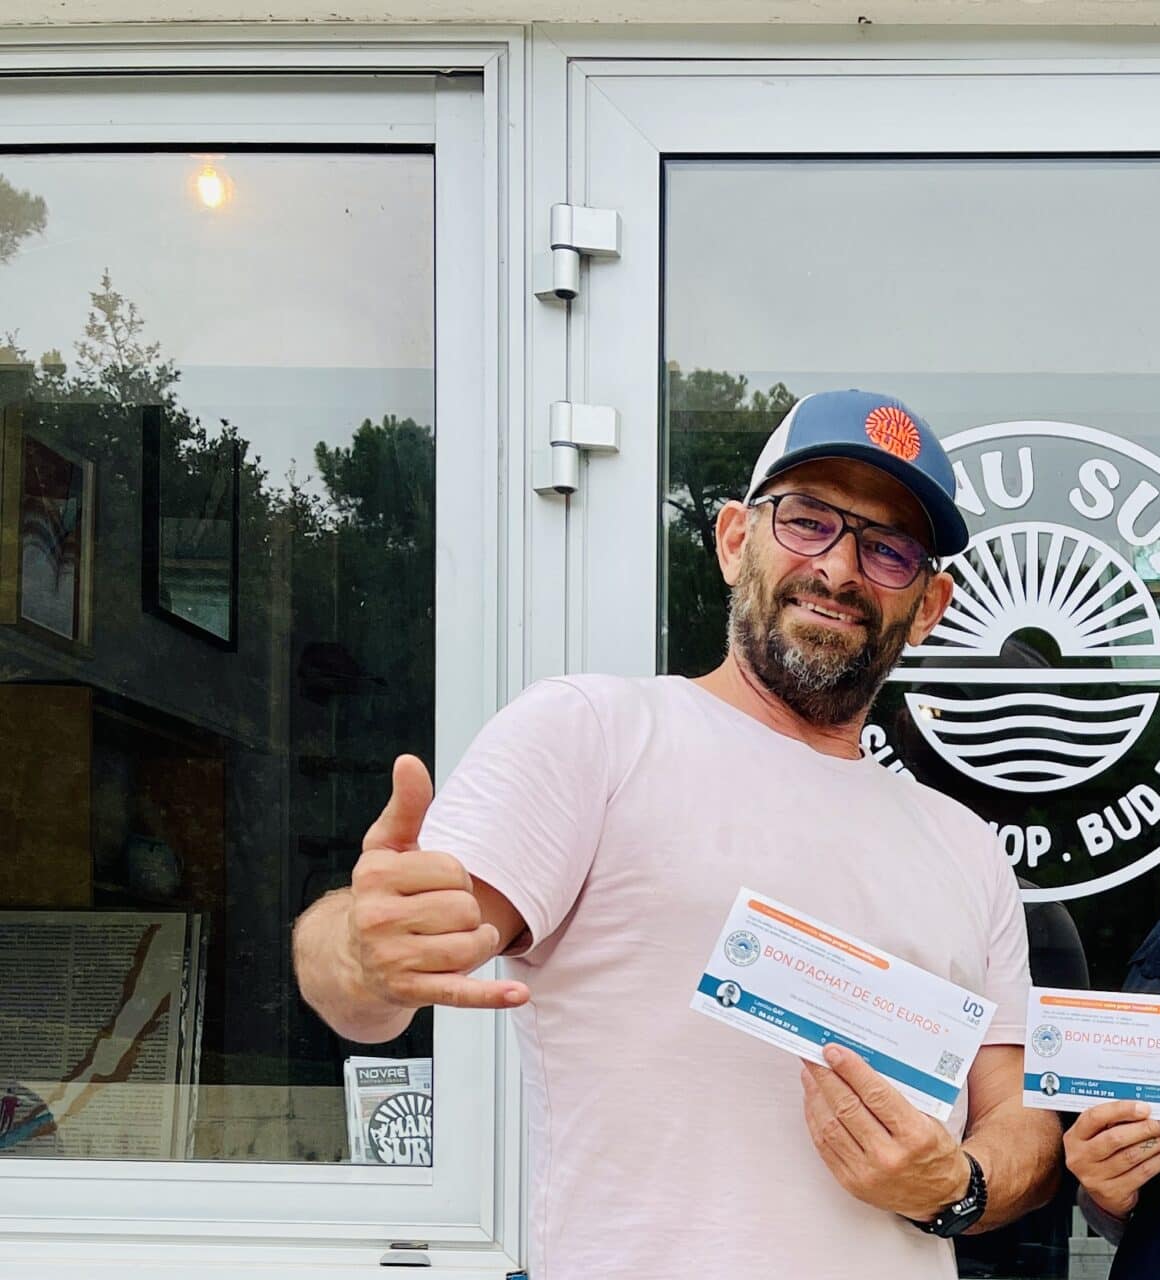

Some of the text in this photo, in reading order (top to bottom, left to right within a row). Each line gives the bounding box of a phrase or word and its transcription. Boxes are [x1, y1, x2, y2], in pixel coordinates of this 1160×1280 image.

[764, 945, 794, 967] BON
[795, 961, 851, 990] D'ACHAT
[852, 986, 871, 1001] DE
[872, 996, 895, 1013] 500
[896, 1007, 941, 1034] EUROS
[1065, 1030, 1090, 1042] BON
[1093, 1033, 1144, 1048] D'ACHAT
[359, 1068, 407, 1080] NOVAE
[389, 1113, 433, 1138] MAN
